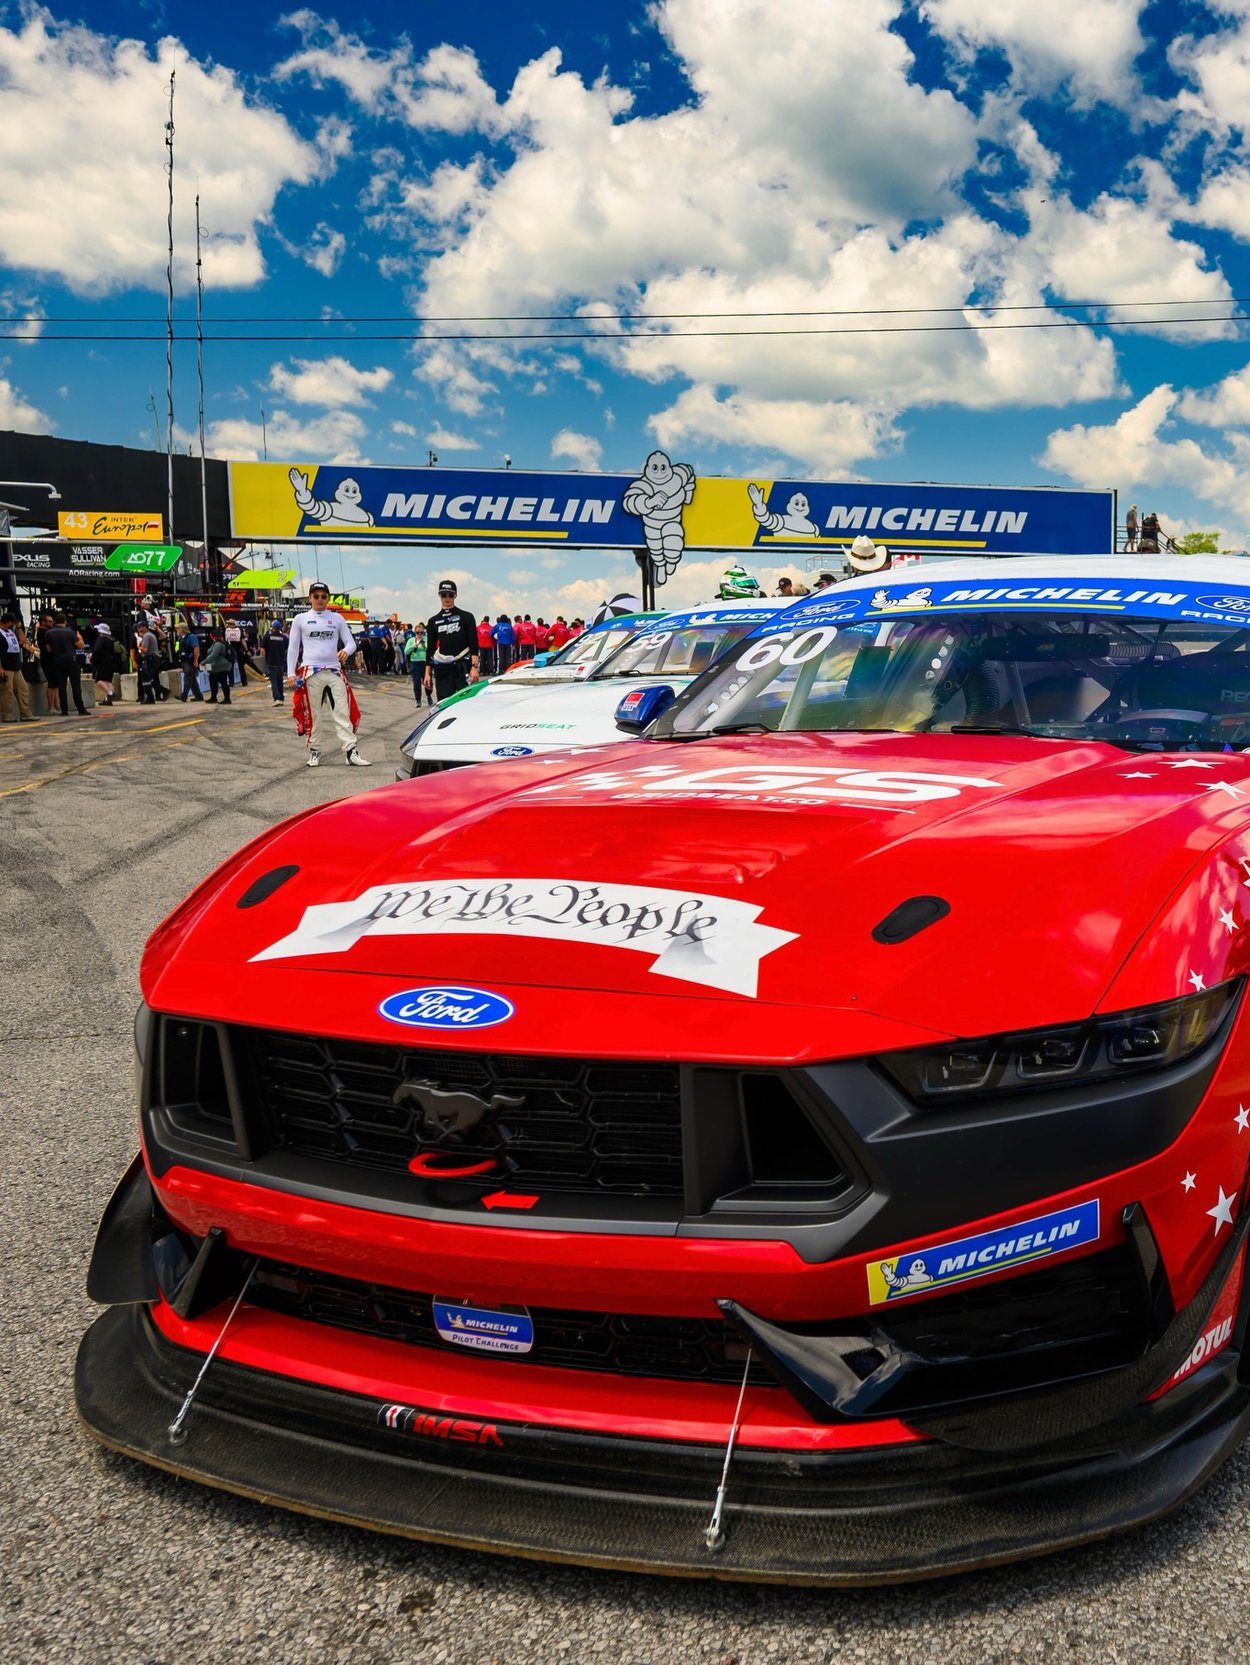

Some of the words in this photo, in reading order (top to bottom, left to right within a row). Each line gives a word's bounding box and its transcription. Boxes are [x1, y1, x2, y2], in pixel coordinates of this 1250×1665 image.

[380, 493, 618, 523] MICHELIN
[64, 513, 88, 528] 43
[92, 516, 149, 536] Europol
[825, 505, 1028, 534] MICHELIN
[12, 553, 50, 562] EXUS
[71, 554, 107, 563] SULLIVAN
[72, 546, 103, 554] VASSER
[69, 569, 120, 578] AORacing.com
[940, 586, 1188, 607] MICHELIN
[719, 612, 777, 621] MICH
[793, 601, 845, 617] Ford
[761, 613, 855, 633] RACING
[735, 625, 838, 672] 60
[642, 766, 1006, 802] GS
[611, 792, 828, 805] GRIDSEAT.CO
[364, 886, 455, 925] We
[509, 883, 719, 945] People
[399, 989, 486, 1024] Ford
[937, 1219, 1081, 1276] MICHELIN
[465, 1318, 519, 1334] MICHELIN
[452, 1333, 474, 1344] PILOT
[476, 1335, 520, 1351] CHALLENGE
[1173, 1315, 1233, 1381] MOTUL
[413, 1412, 504, 1447] IMSA
